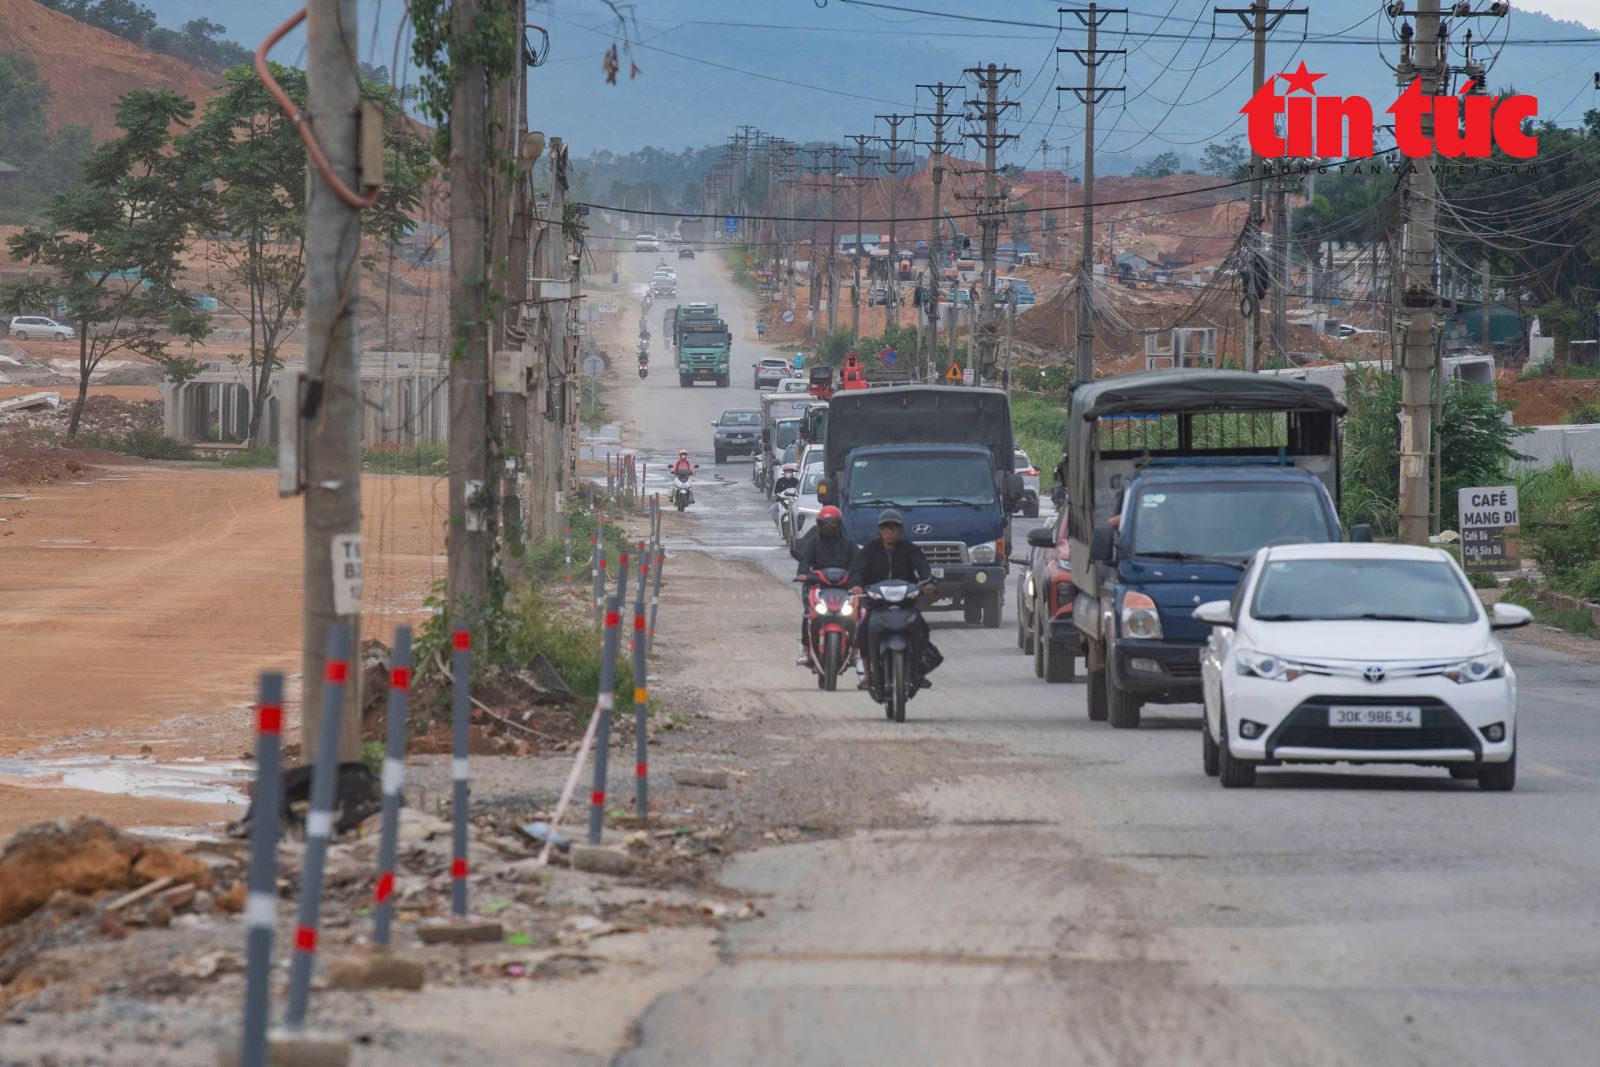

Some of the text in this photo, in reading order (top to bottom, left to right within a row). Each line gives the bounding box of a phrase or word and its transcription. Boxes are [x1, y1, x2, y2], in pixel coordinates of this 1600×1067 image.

[1472, 490, 1508, 507] CAFÉ
[1464, 510, 1517, 525] MANG ĐI
